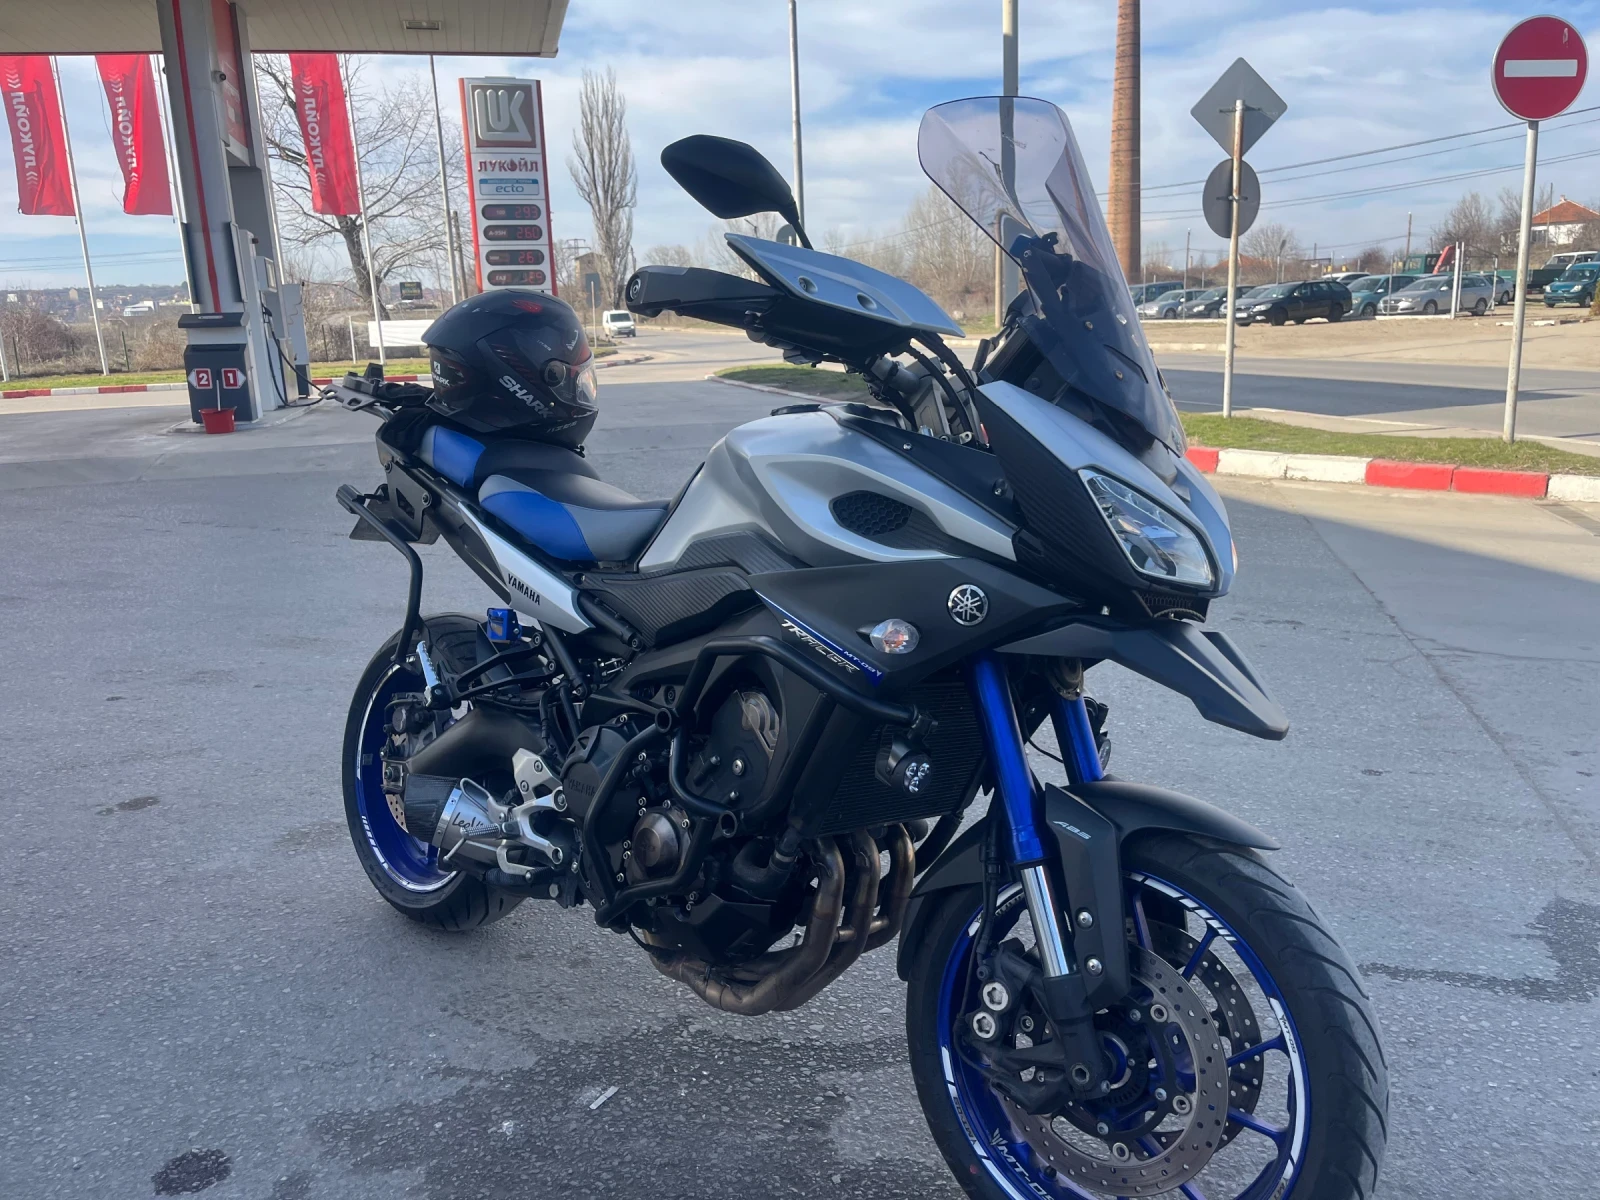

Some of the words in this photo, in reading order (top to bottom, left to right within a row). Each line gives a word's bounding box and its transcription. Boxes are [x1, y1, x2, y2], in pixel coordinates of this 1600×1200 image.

[478, 157, 539, 172] ЛУКОЙЛ
[495, 184, 525, 193] ecto
[515, 205, 538, 219] 293
[516, 226, 540, 239] 260
[198, 373, 209, 385] 2
[227, 373, 234, 385] 1
[499, 375, 553, 418] SHARK
[507, 573, 541, 606] YAMAHA
[781, 618, 861, 673] TRACER
[1052, 820, 1092, 840] ABS
